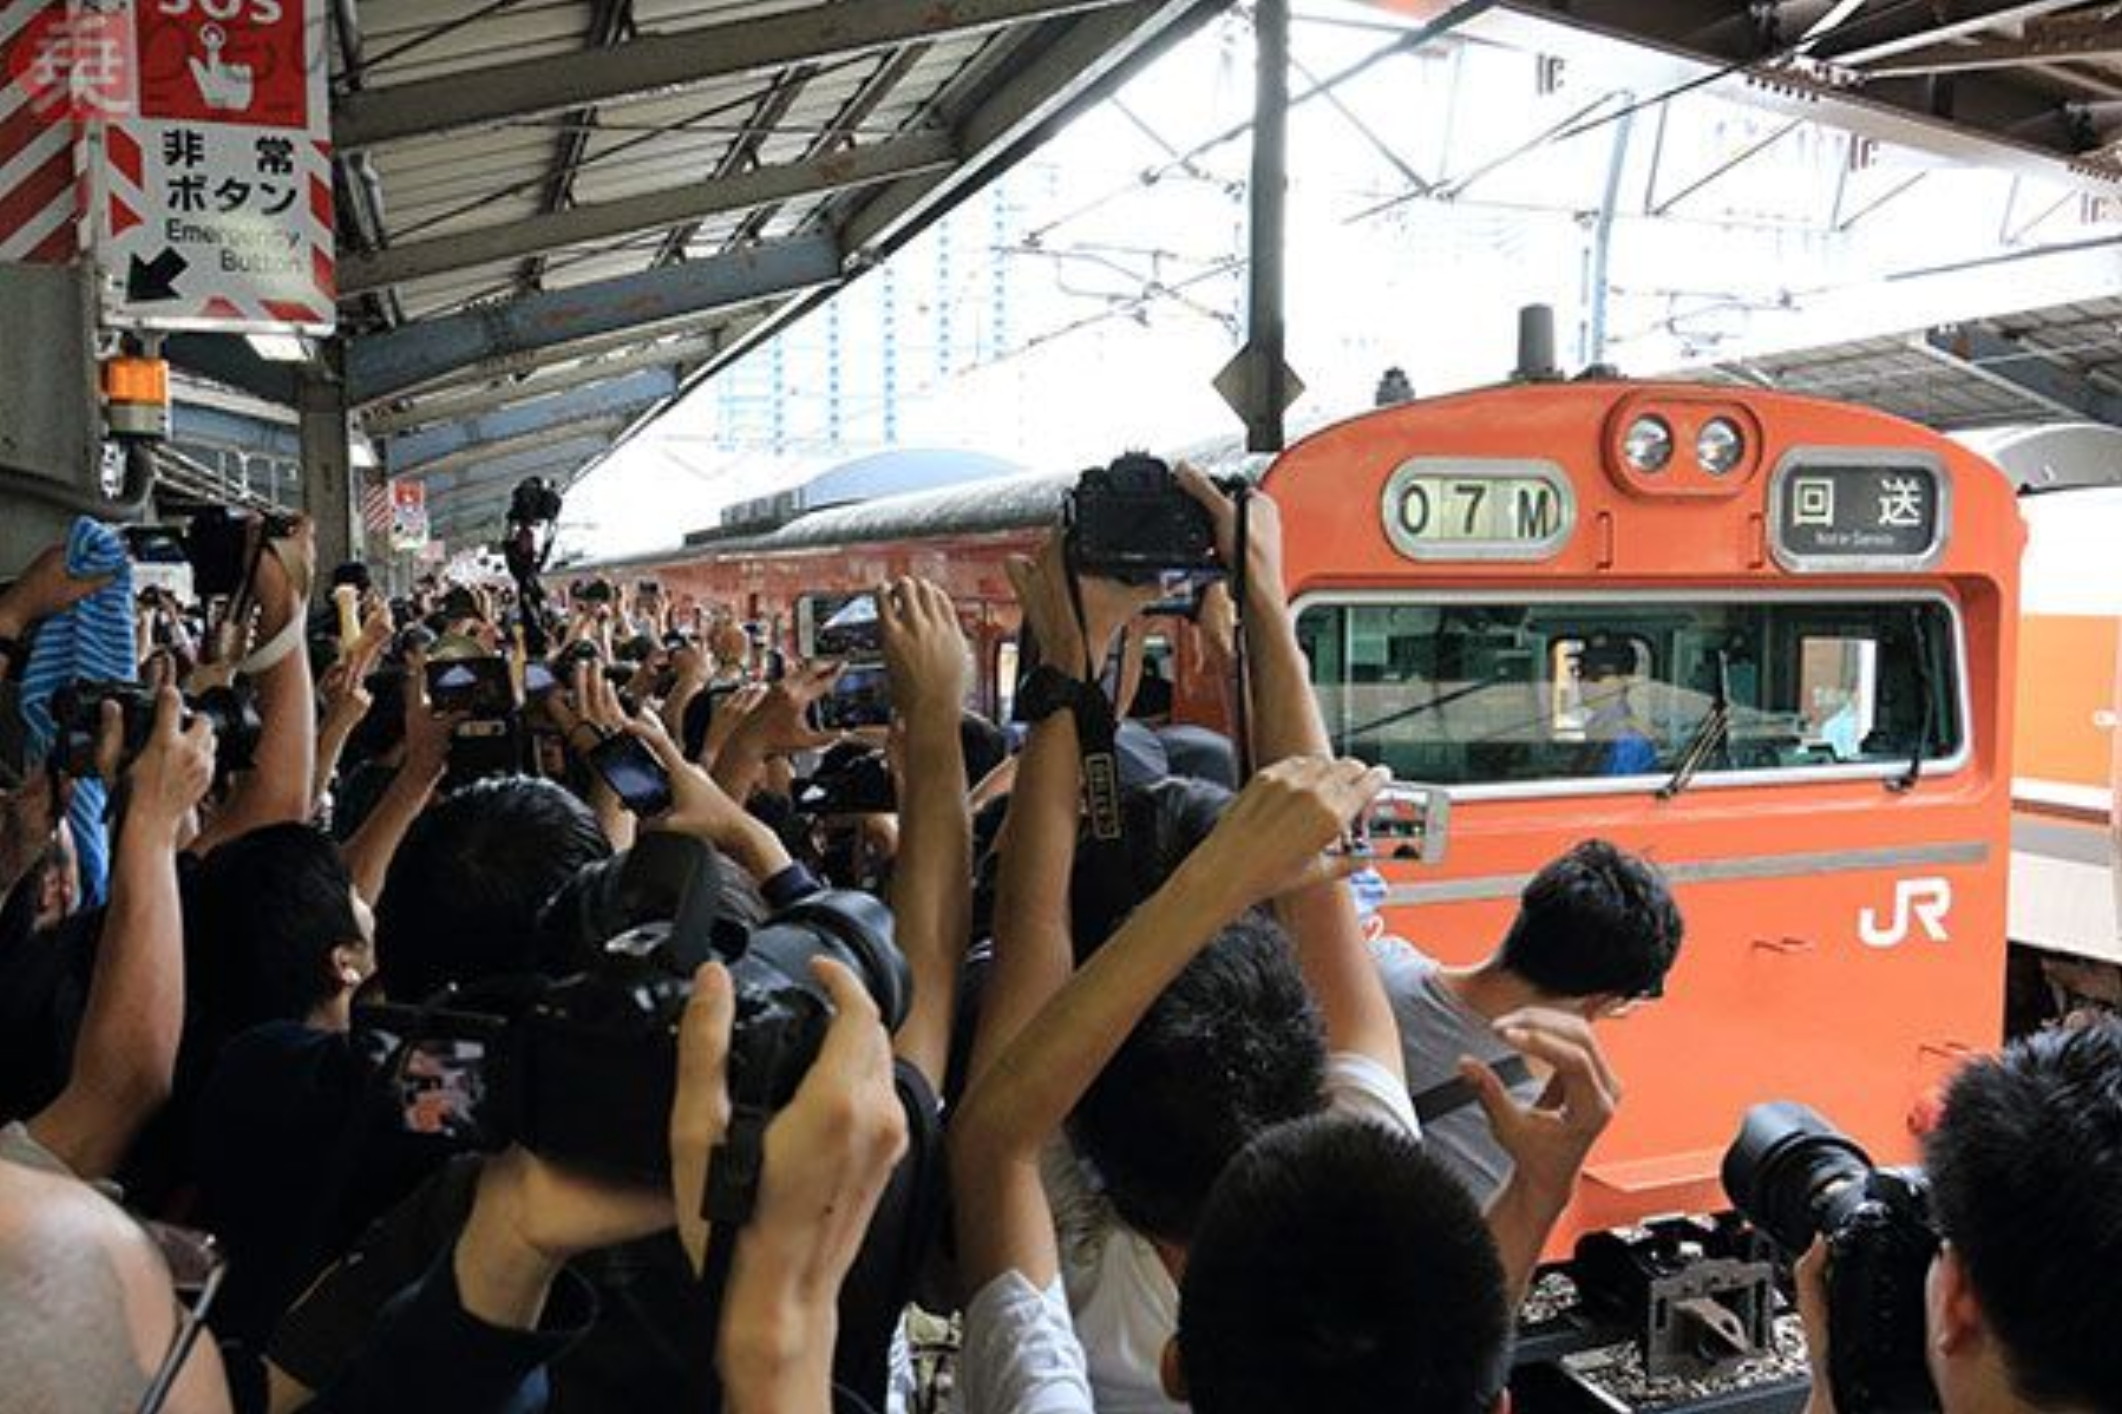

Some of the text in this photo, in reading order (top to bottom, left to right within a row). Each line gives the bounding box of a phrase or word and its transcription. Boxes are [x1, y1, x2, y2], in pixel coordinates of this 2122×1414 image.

[163, 129, 293, 174] 非常
[167, 175, 297, 215] ボタン
[221, 249, 303, 272] Buttn
[1793, 477, 1922, 528] 回送
[1859, 877, 1951, 946] JR
